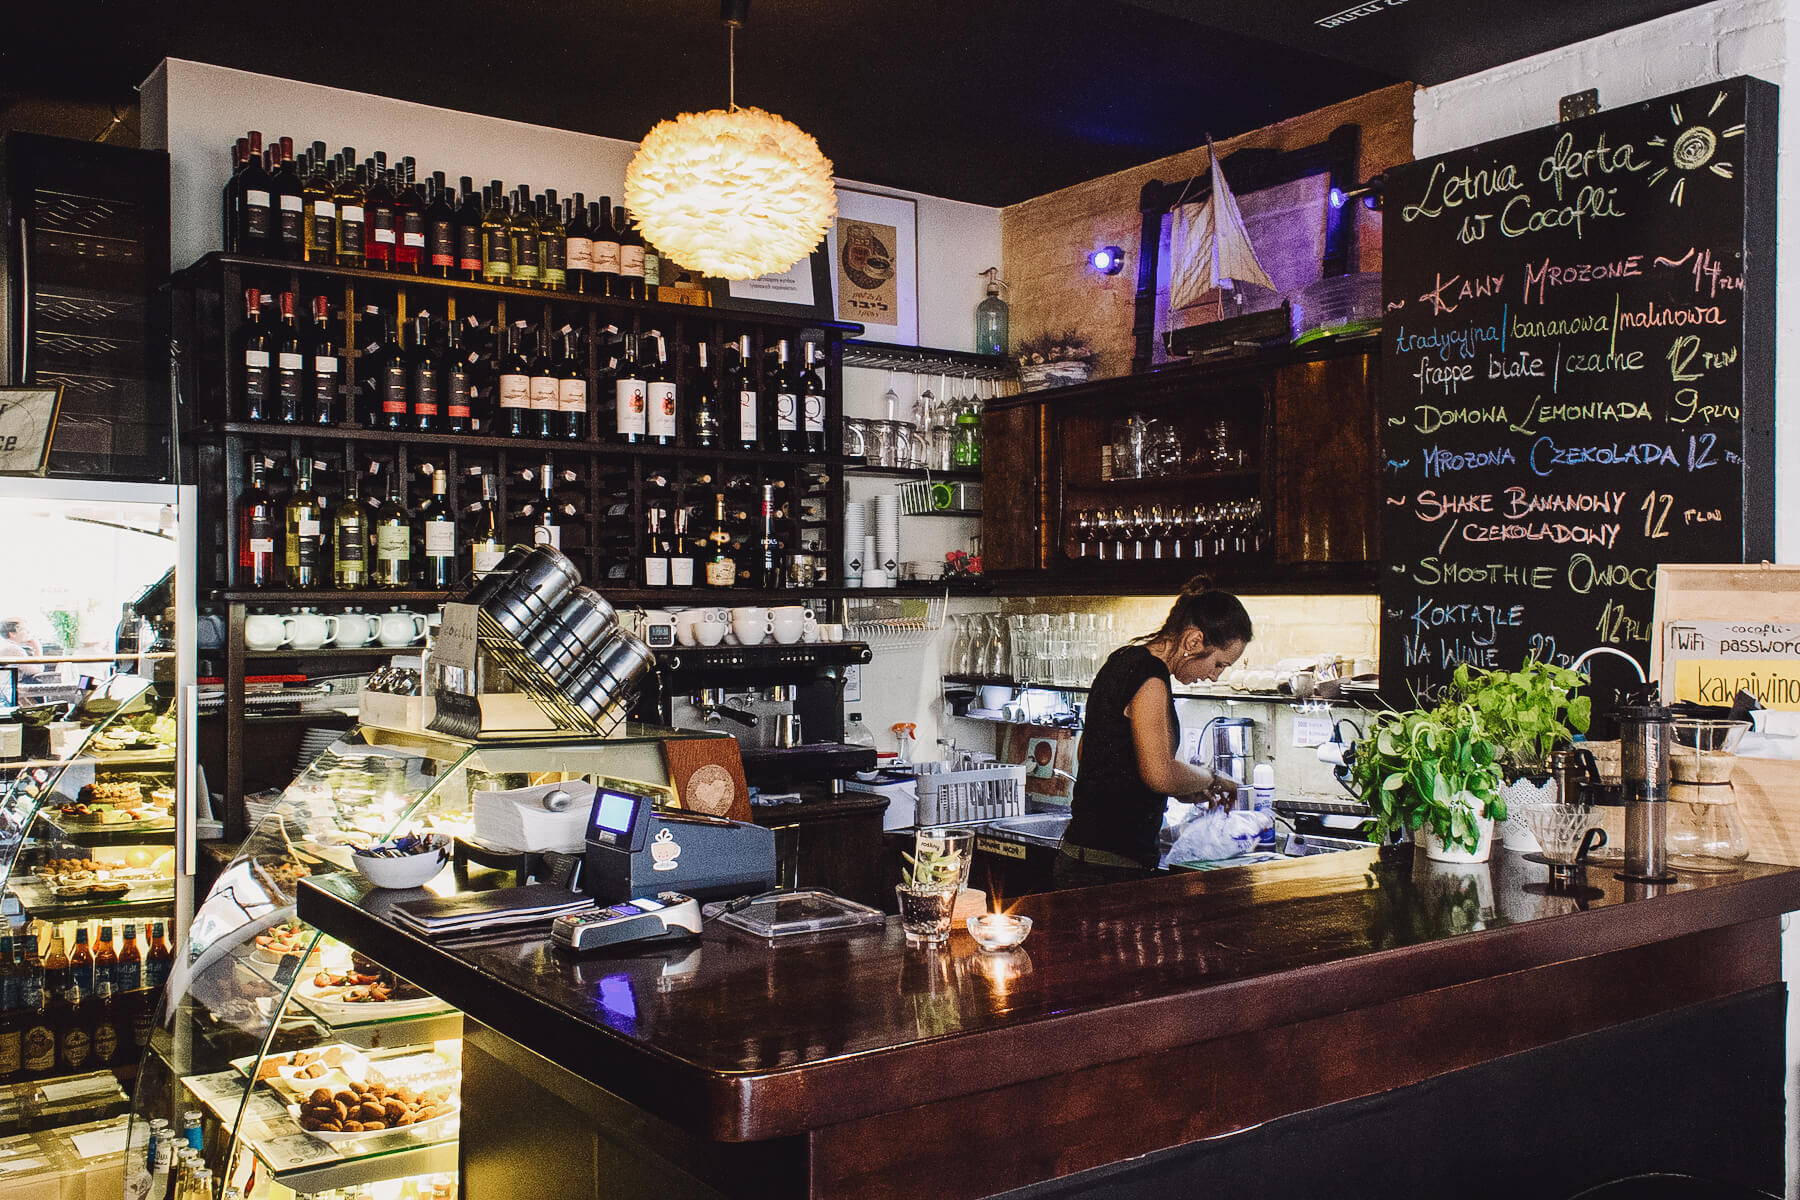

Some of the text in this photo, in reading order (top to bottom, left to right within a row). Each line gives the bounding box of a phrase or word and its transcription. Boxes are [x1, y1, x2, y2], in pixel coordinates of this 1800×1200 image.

[1402, 131, 1650, 223] Letnia oferta
[1500, 185, 1627, 240] Cocofli
[1419, 272, 1505, 316] KAWY
[1692, 248, 1722, 299] 14
[1413, 356, 1475, 396] frappe
[1666, 335, 1704, 381] 12
[1414, 404, 1509, 434] DOMOWA
[1510, 395, 1653, 436] LEMONIADA
[1670, 388, 1699, 423] 9
[1529, 436, 1680, 477] CZEKOLADA
[1687, 433, 1719, 472] 12
[1415, 489, 1495, 521] SHAKE
[1640, 489, 1675, 539] 12
[1413, 556, 1557, 590] SMOOTHIE
[1410, 596, 1525, 647] KOKTAJLE
[1595, 598, 1625, 643] 12
[1403, 634, 1432, 669] NA
